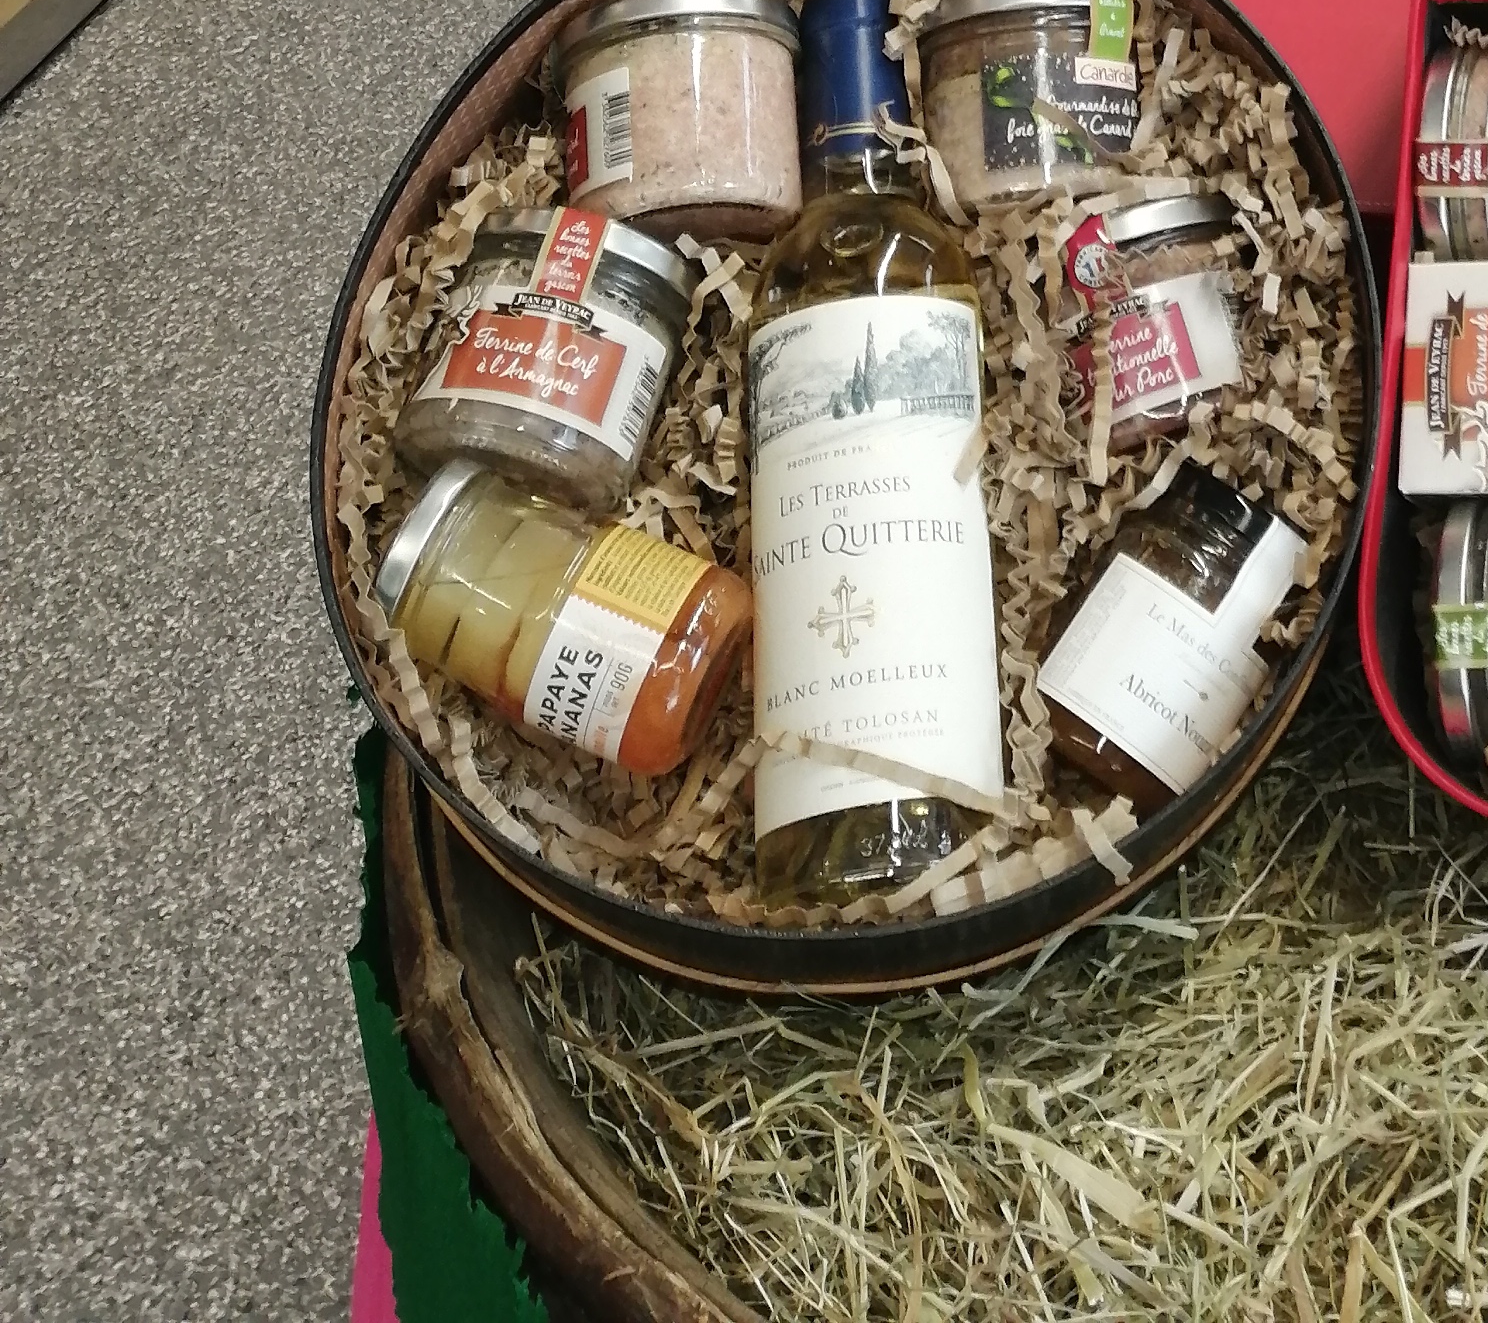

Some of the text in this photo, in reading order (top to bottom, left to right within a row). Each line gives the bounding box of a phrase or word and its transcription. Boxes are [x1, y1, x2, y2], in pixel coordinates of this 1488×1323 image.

[515, 294, 543, 307] JEAN
[556, 299, 592, 320] VEYRAC
[474, 327, 600, 380] Terrine de Cerf
[1111, 328, 1153, 353] errine
[1427, 323, 1445, 375] VEYRAC
[489, 358, 579, 398] l'Armagnac
[1136, 367, 1174, 393] Porc
[1466, 334, 1488, 396] Terrine
[1428, 394, 1445, 429] JEAN
[787, 448, 847, 471] PRODUIT DE
[779, 476, 911, 517] LES TERRASSES
[832, 506, 849, 519] DE
[821, 521, 965, 558] QUITTERIE
[1146, 602, 1218, 667] Le Mas des
[766, 663, 949, 712] BLANC MOELLEUX
[1119, 672, 1180, 726] Abricot
[841, 709, 940, 734] TOLOSAN
